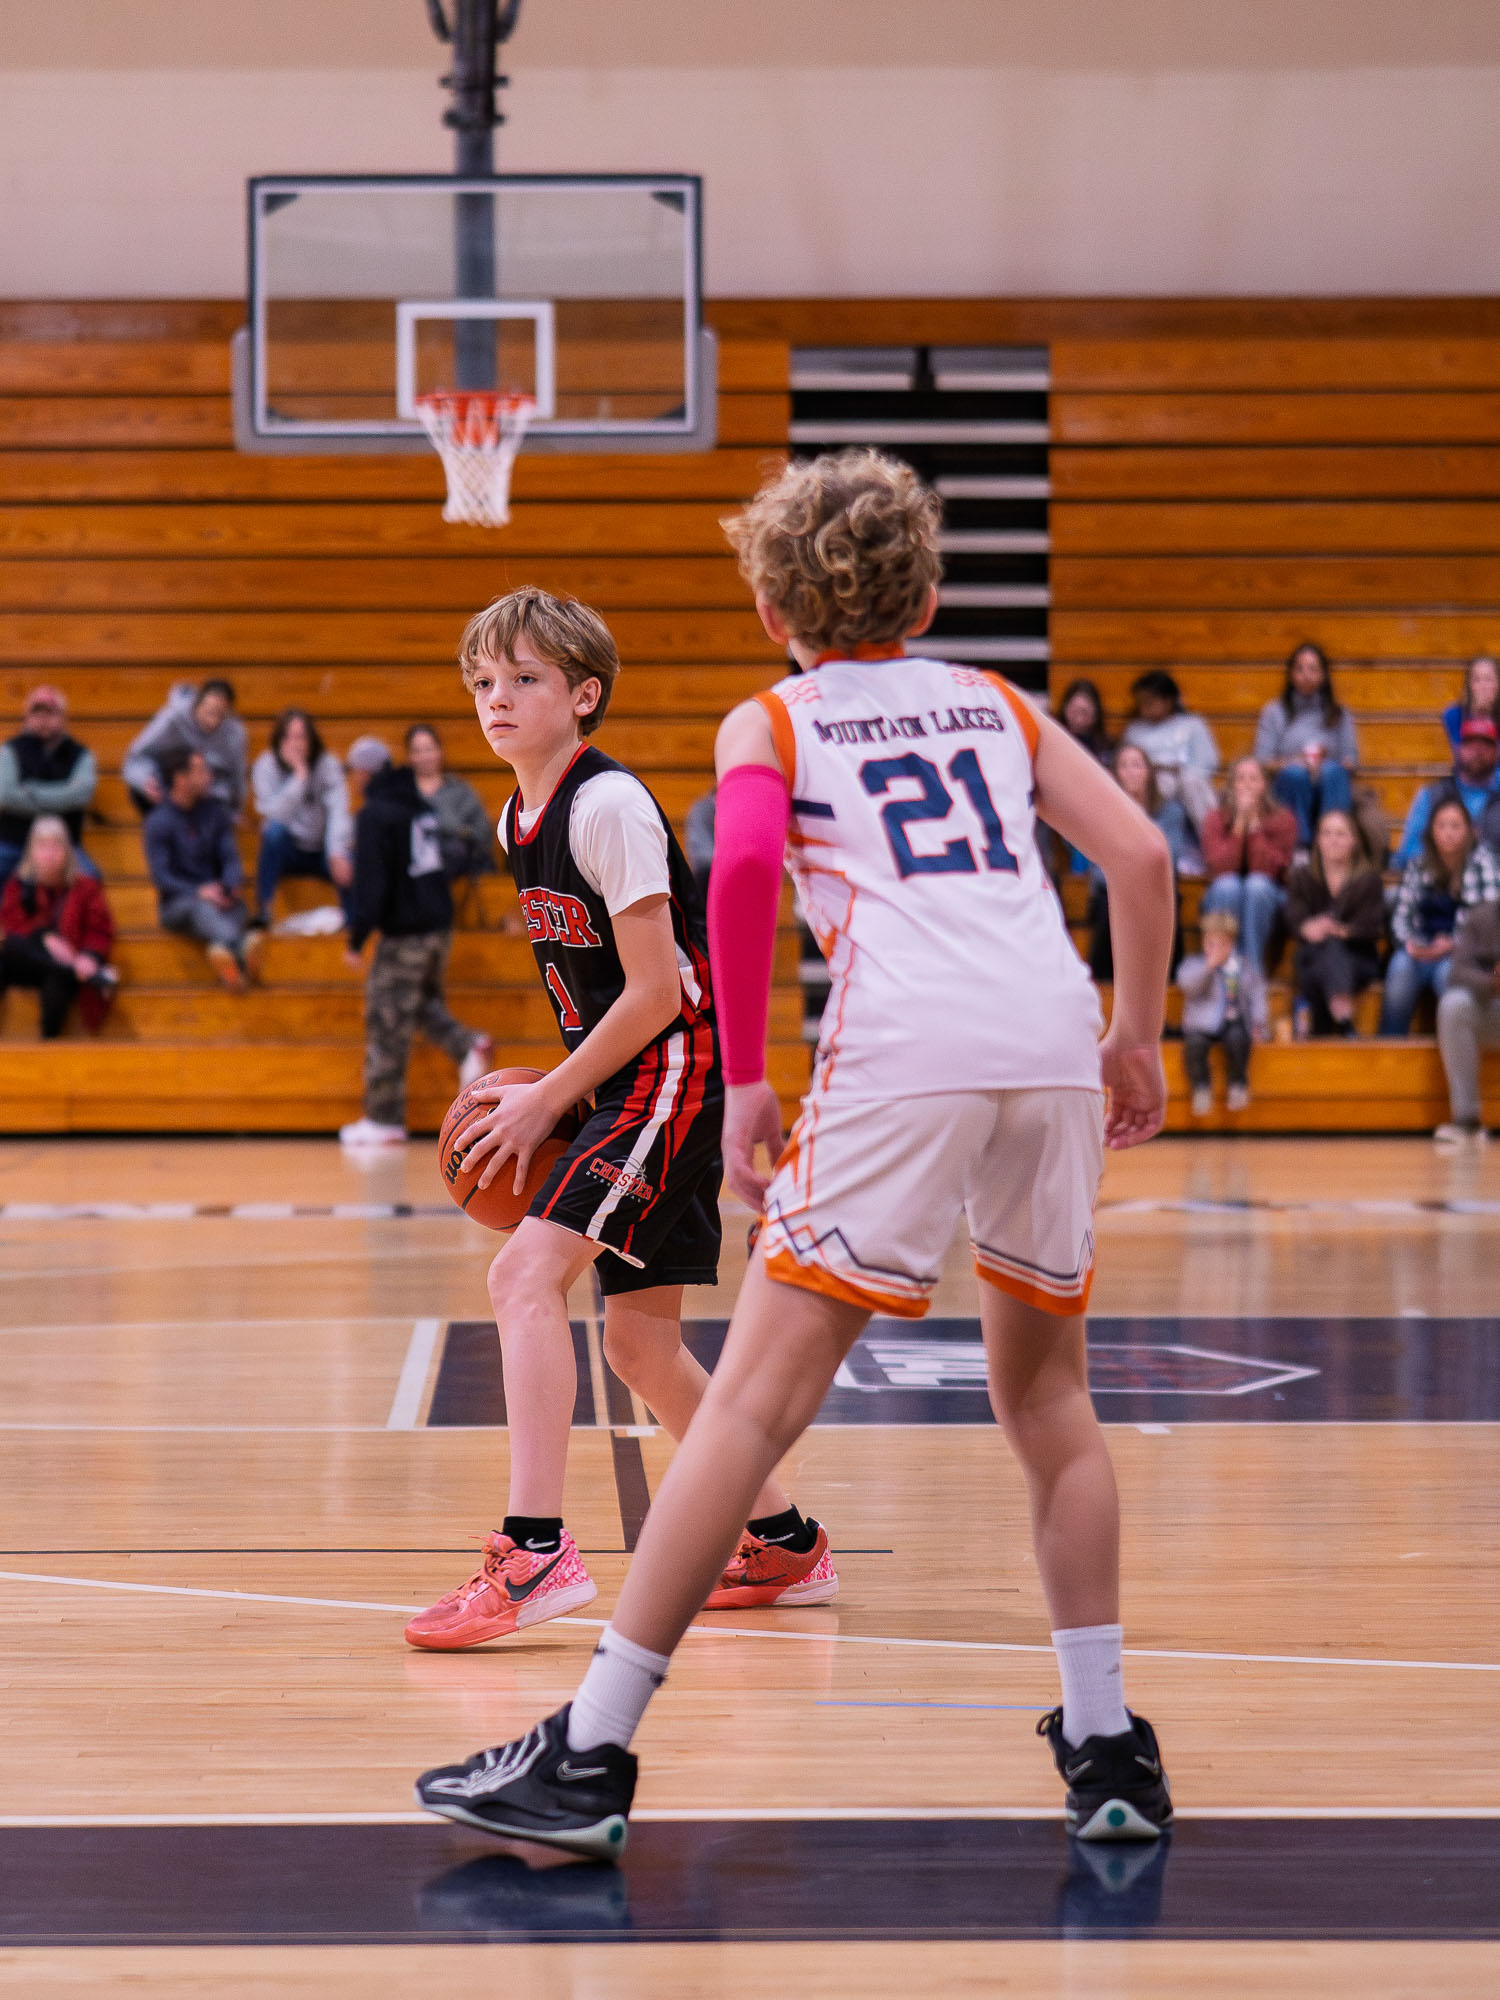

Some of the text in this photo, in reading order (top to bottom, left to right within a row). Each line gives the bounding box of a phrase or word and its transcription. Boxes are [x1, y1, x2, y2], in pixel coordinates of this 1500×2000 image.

[927, 707, 1004, 733] LAKES
[858, 747, 1021, 881] 21
[546, 962, 584, 1031] 1
[589, 1157, 654, 1201] CHESTER
